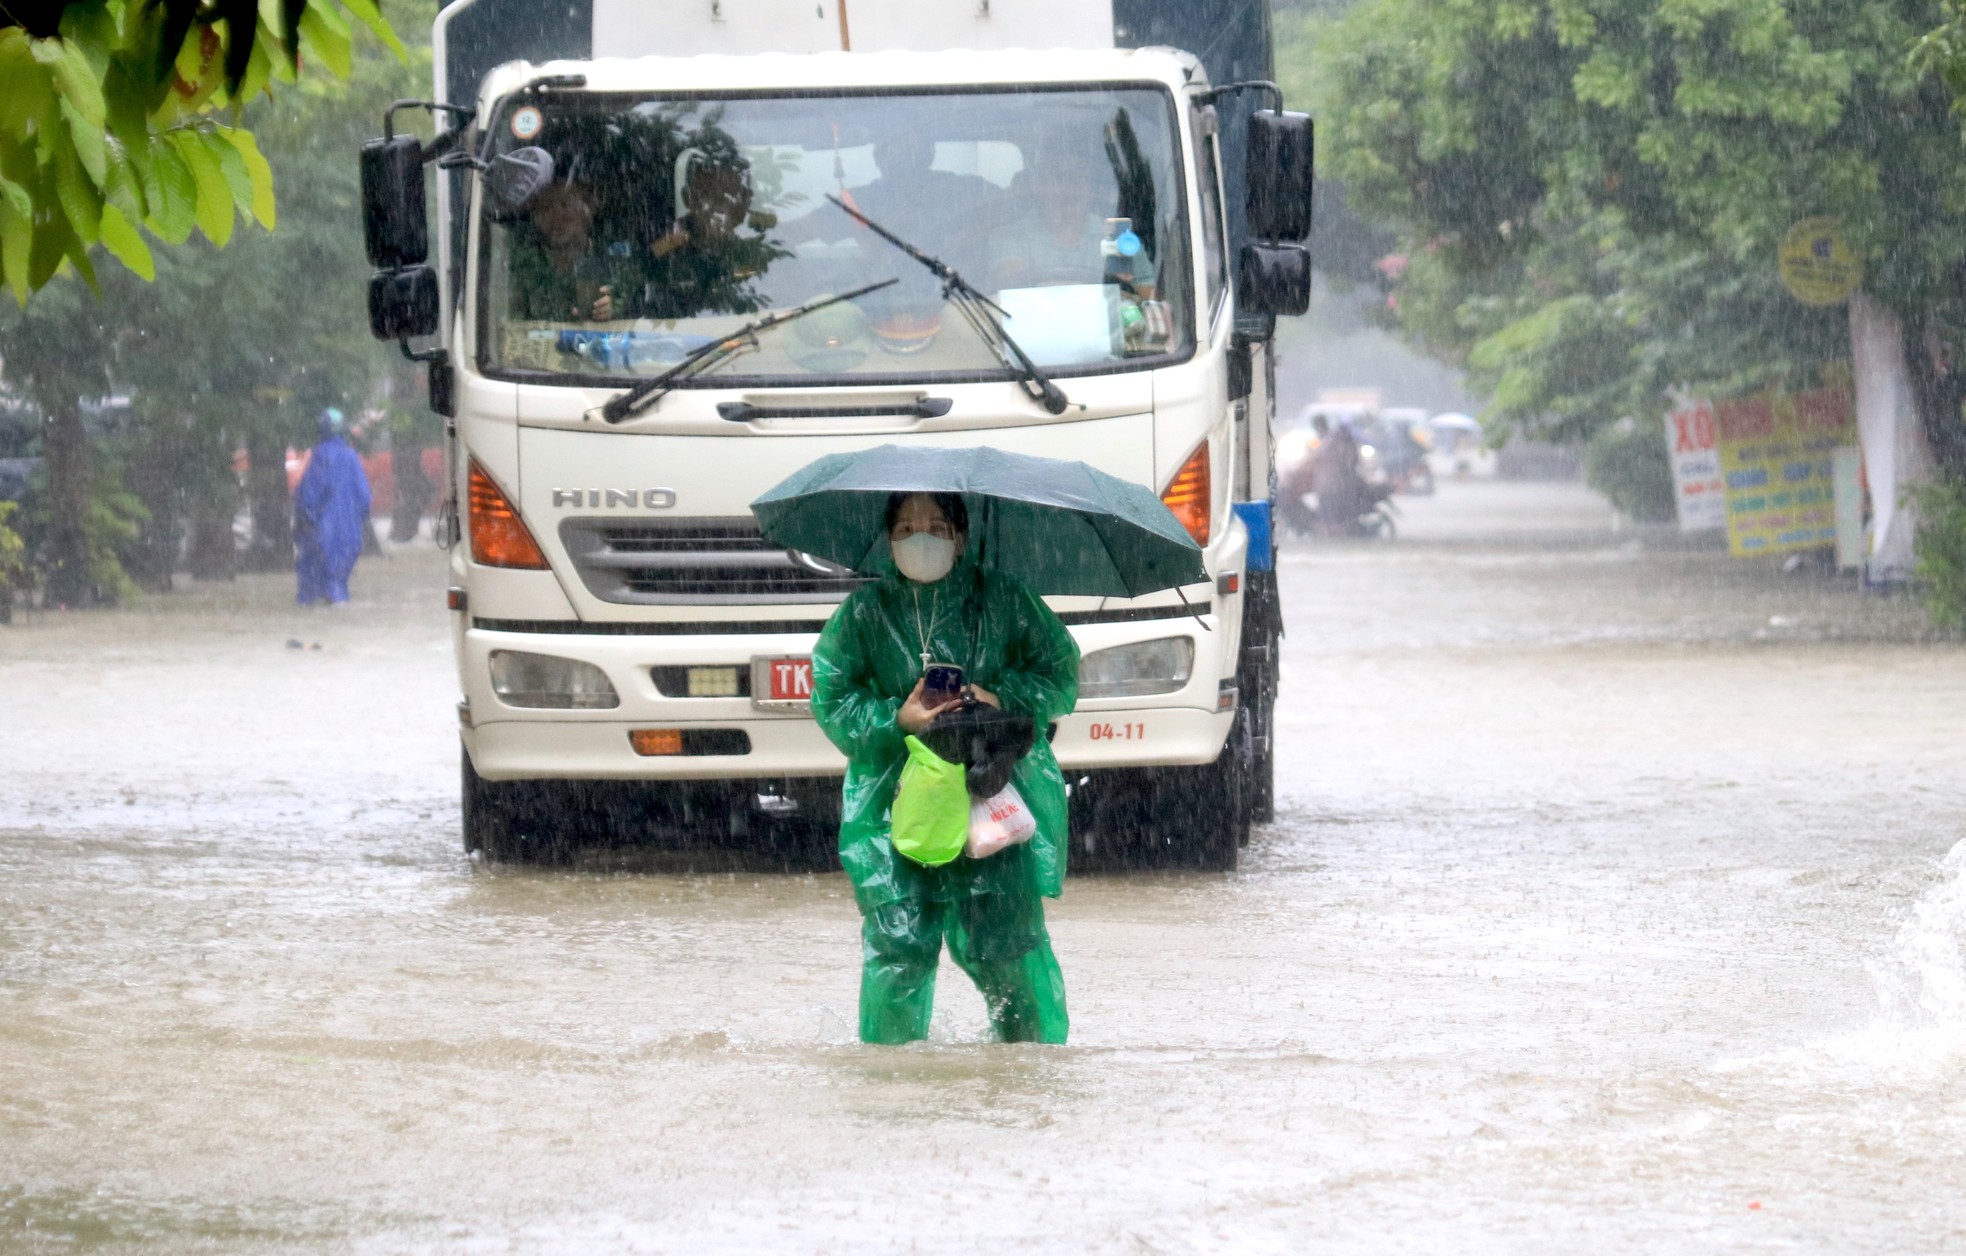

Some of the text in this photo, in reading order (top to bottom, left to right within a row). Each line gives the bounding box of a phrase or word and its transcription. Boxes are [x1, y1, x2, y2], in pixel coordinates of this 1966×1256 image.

[552, 486, 676, 508] HINO
[776, 664, 810, 695] TK
[1089, 722, 1144, 740] 04-11
